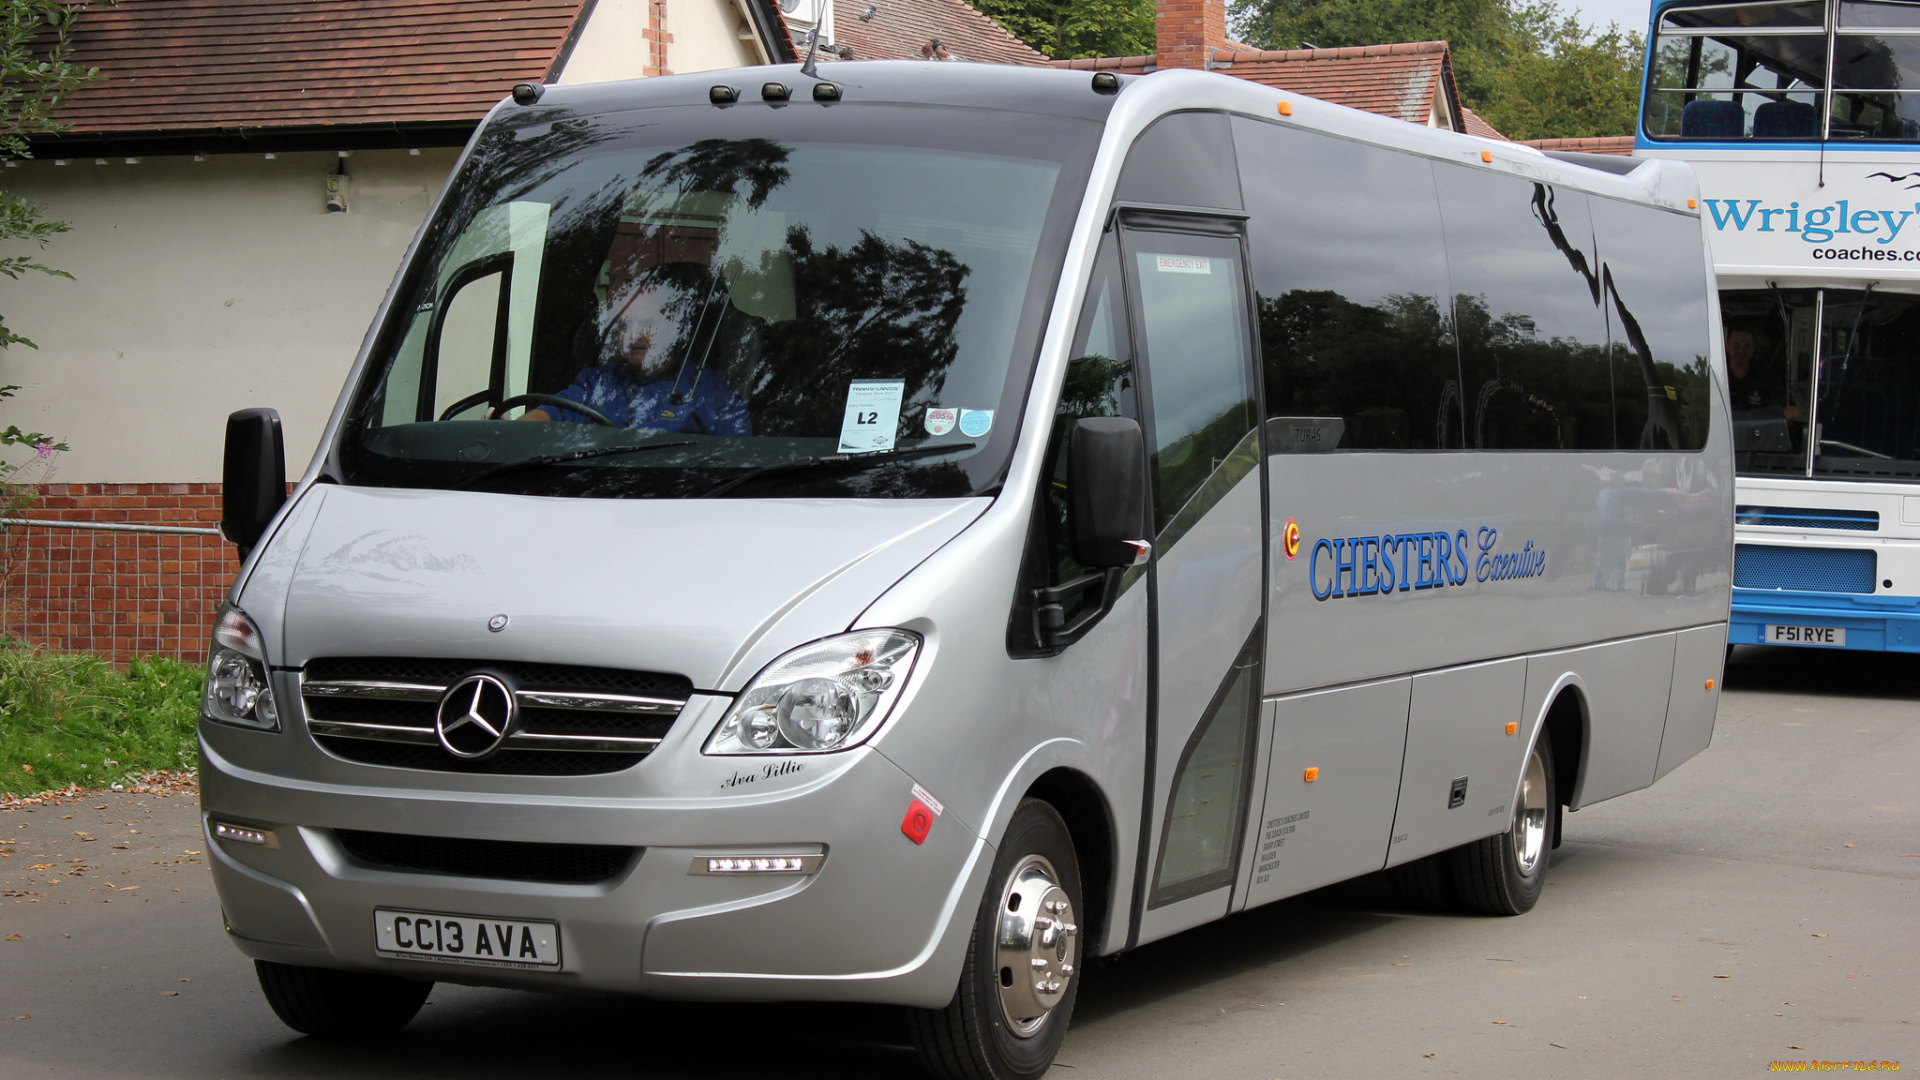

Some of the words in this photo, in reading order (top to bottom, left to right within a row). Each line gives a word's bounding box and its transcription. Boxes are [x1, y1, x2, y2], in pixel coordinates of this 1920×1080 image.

[1703, 199, 1920, 244] Wrigley'
[1159, 258, 1194, 269] EMERGENCY
[1195, 259, 1208, 269] EXIT
[857, 411, 878, 425] L2
[1294, 428, 1321, 442] TURAS
[1310, 529, 1468, 602] CHESTERS
[1476, 526, 1546, 582] Executive
[1775, 626, 1800, 641] F51
[1804, 627, 1834, 643] RYE
[720, 771, 758, 790] Ava
[761, 760, 807, 780] Lillie
[394, 916, 464, 954] CC13
[475, 923, 538, 959] AVA
